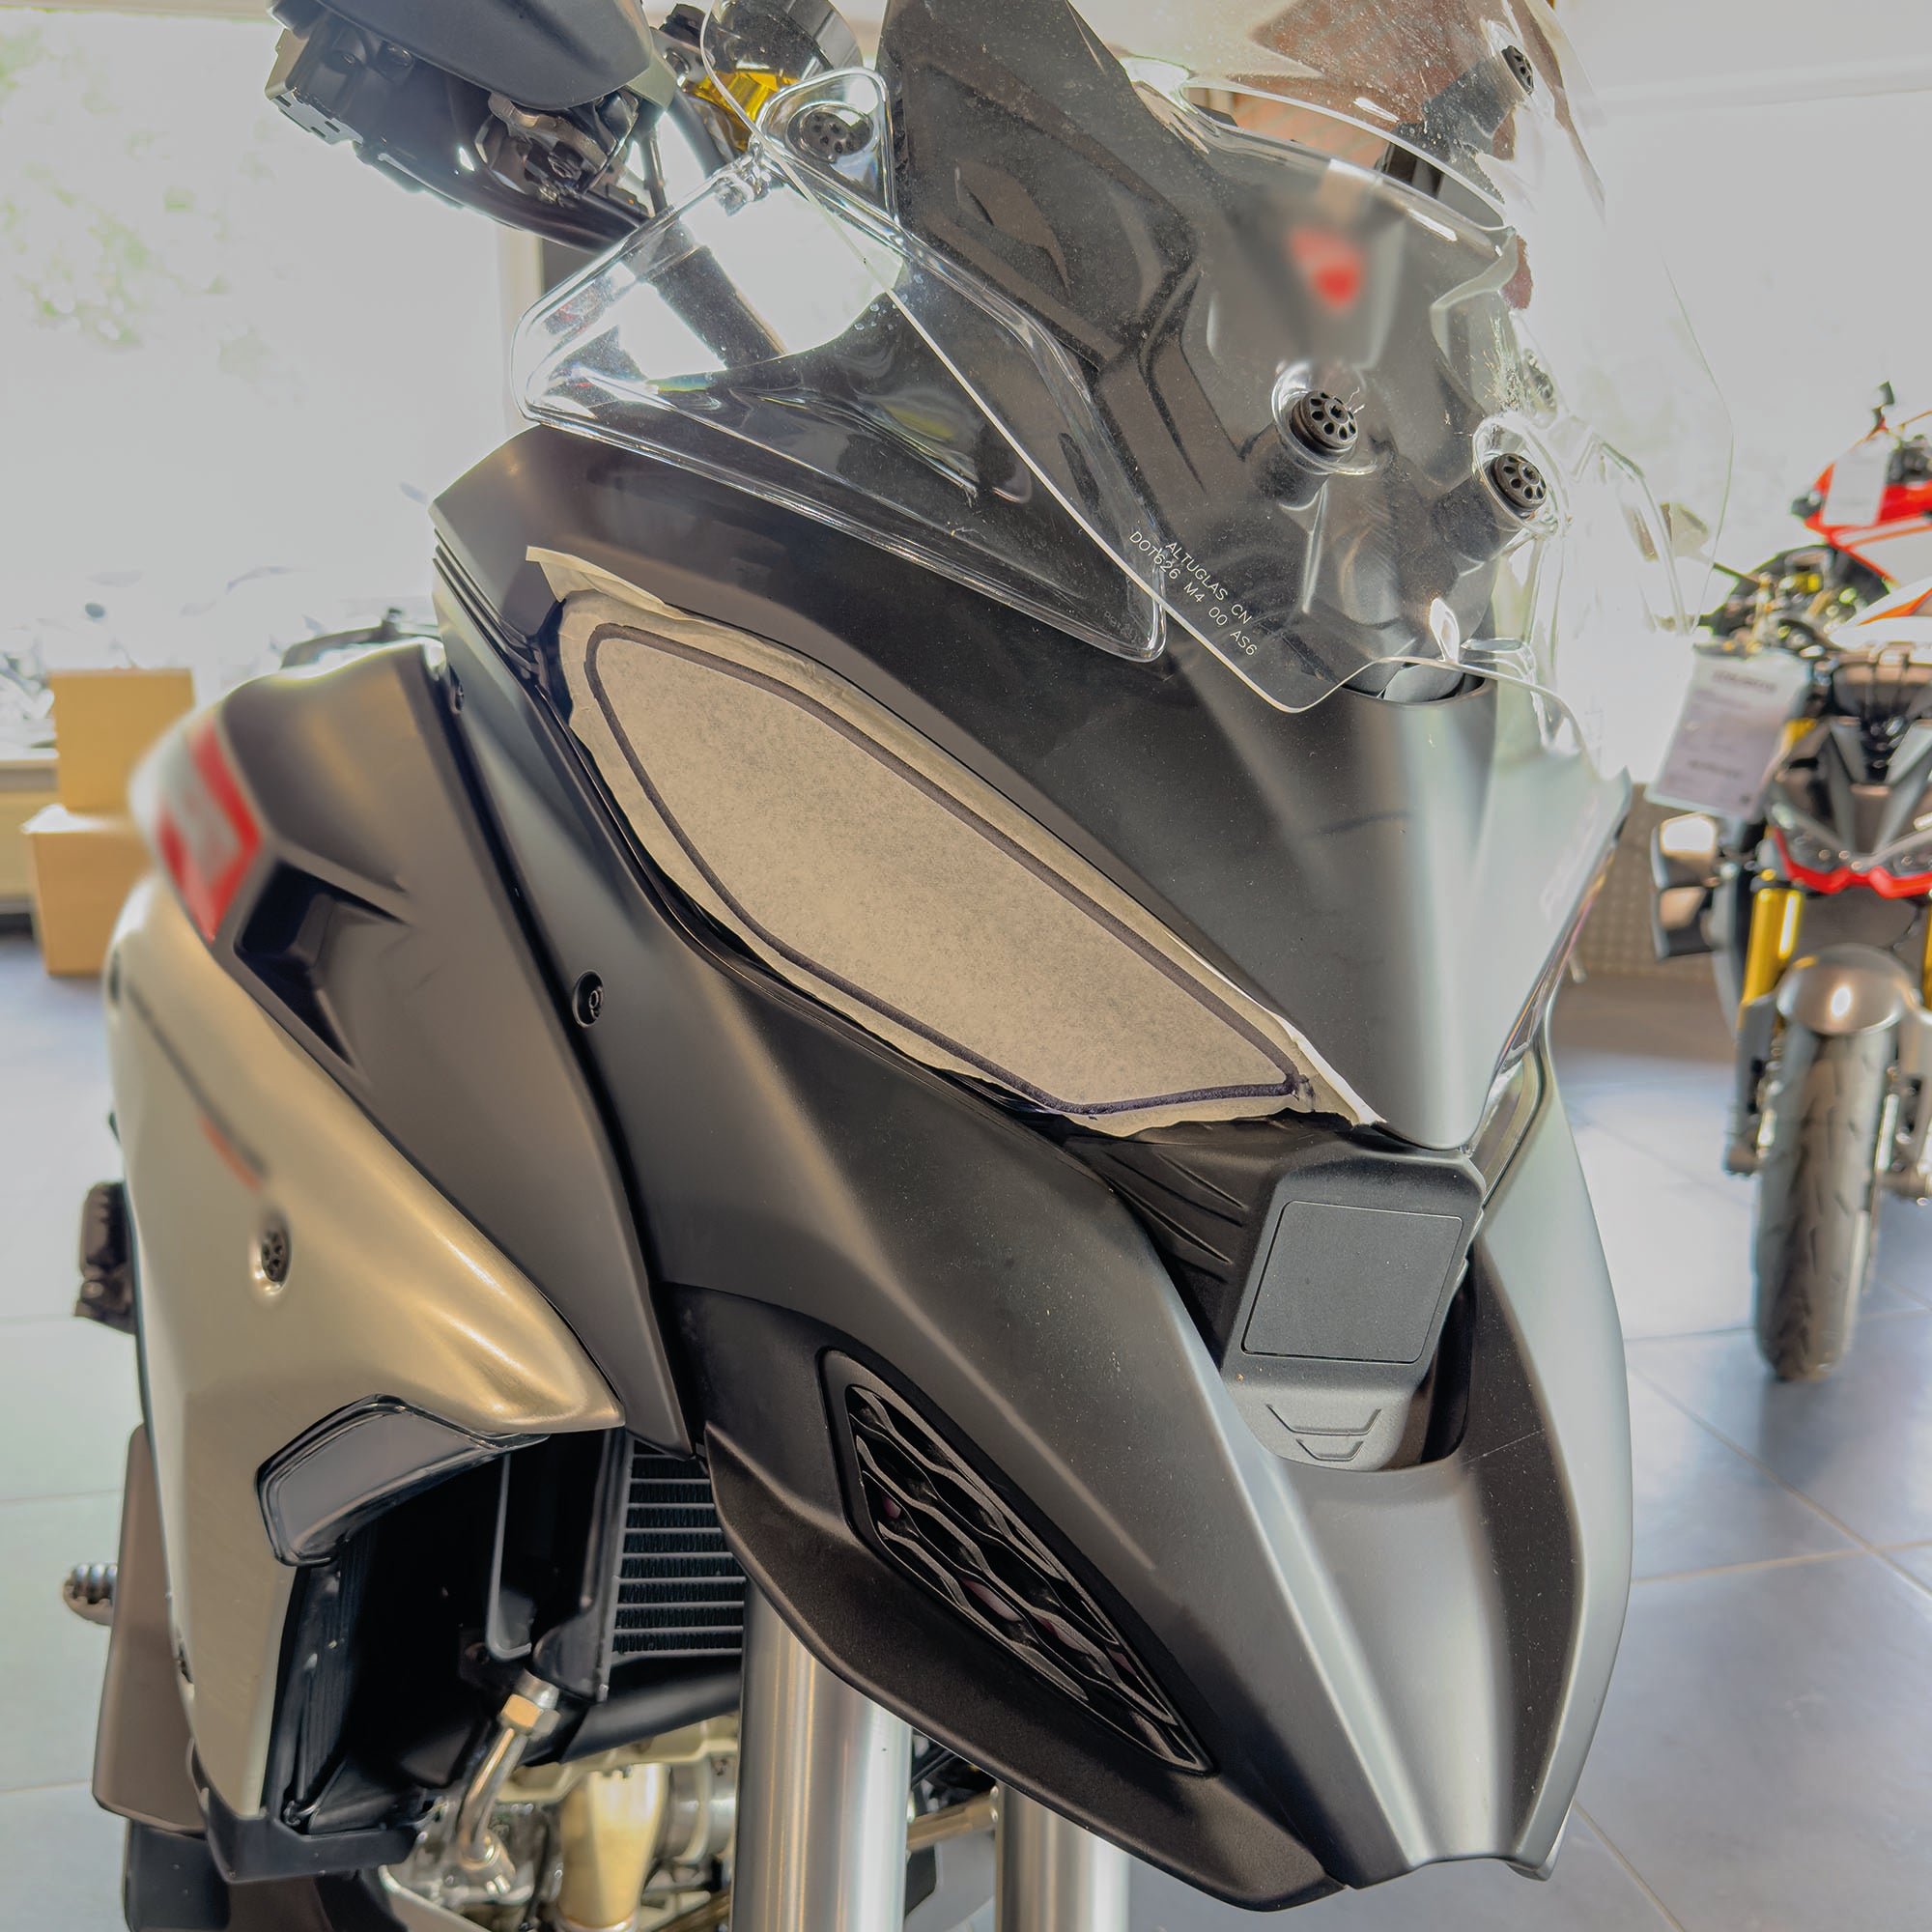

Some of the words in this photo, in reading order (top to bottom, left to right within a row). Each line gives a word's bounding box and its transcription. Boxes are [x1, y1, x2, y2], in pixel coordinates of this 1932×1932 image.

[1129, 531, 1180, 580] DOT626
[1183, 582, 1206, 603] M4
[1230, 630, 1258, 656] AS6
[1165, 542, 1228, 601] ALTUGLAS
[1231, 604, 1253, 625] CN
